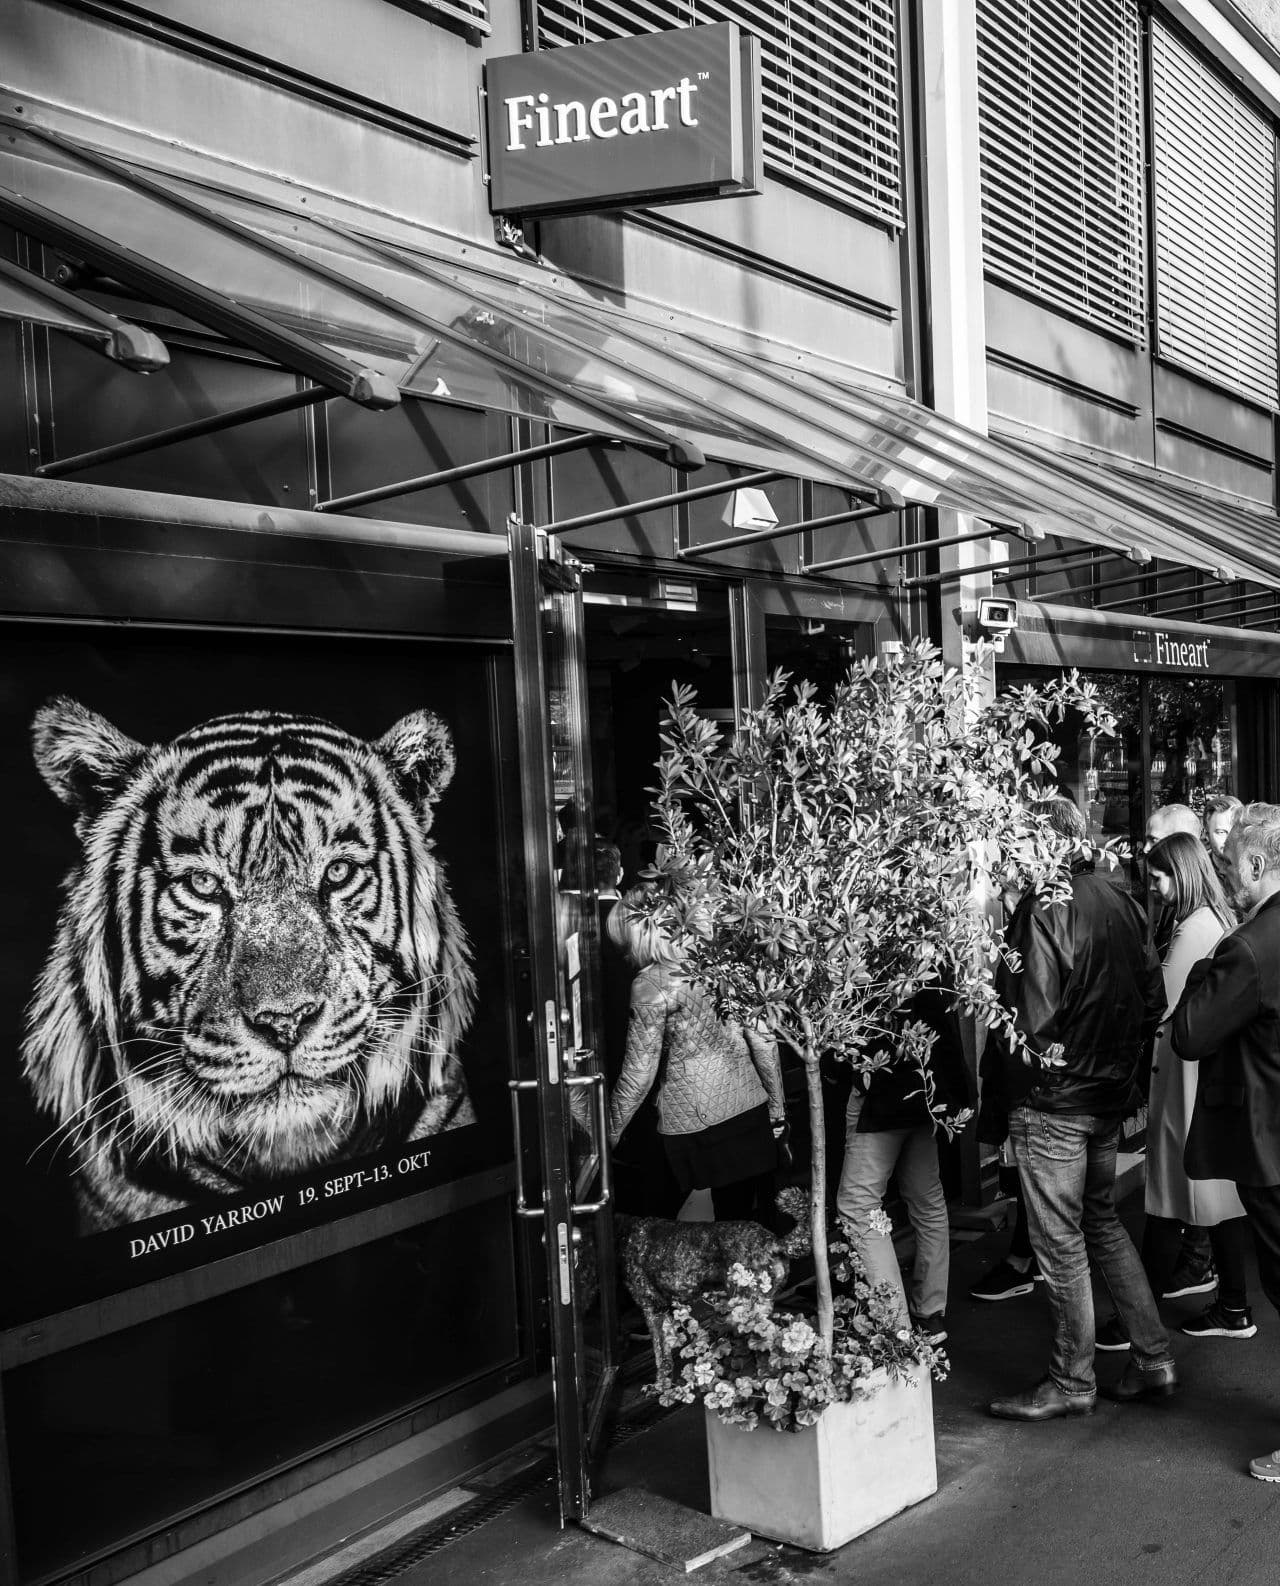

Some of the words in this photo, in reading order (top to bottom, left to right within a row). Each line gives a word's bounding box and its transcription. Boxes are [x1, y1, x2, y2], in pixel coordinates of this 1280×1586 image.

[504, 76, 699, 151] Fineart
[1154, 632, 1210, 668] Fineart
[129, 1223, 195, 1259] DAVID
[201, 1195, 285, 1235] YARROW
[298, 1187, 319, 1206] 19.
[397, 1151, 431, 1175] OKT
